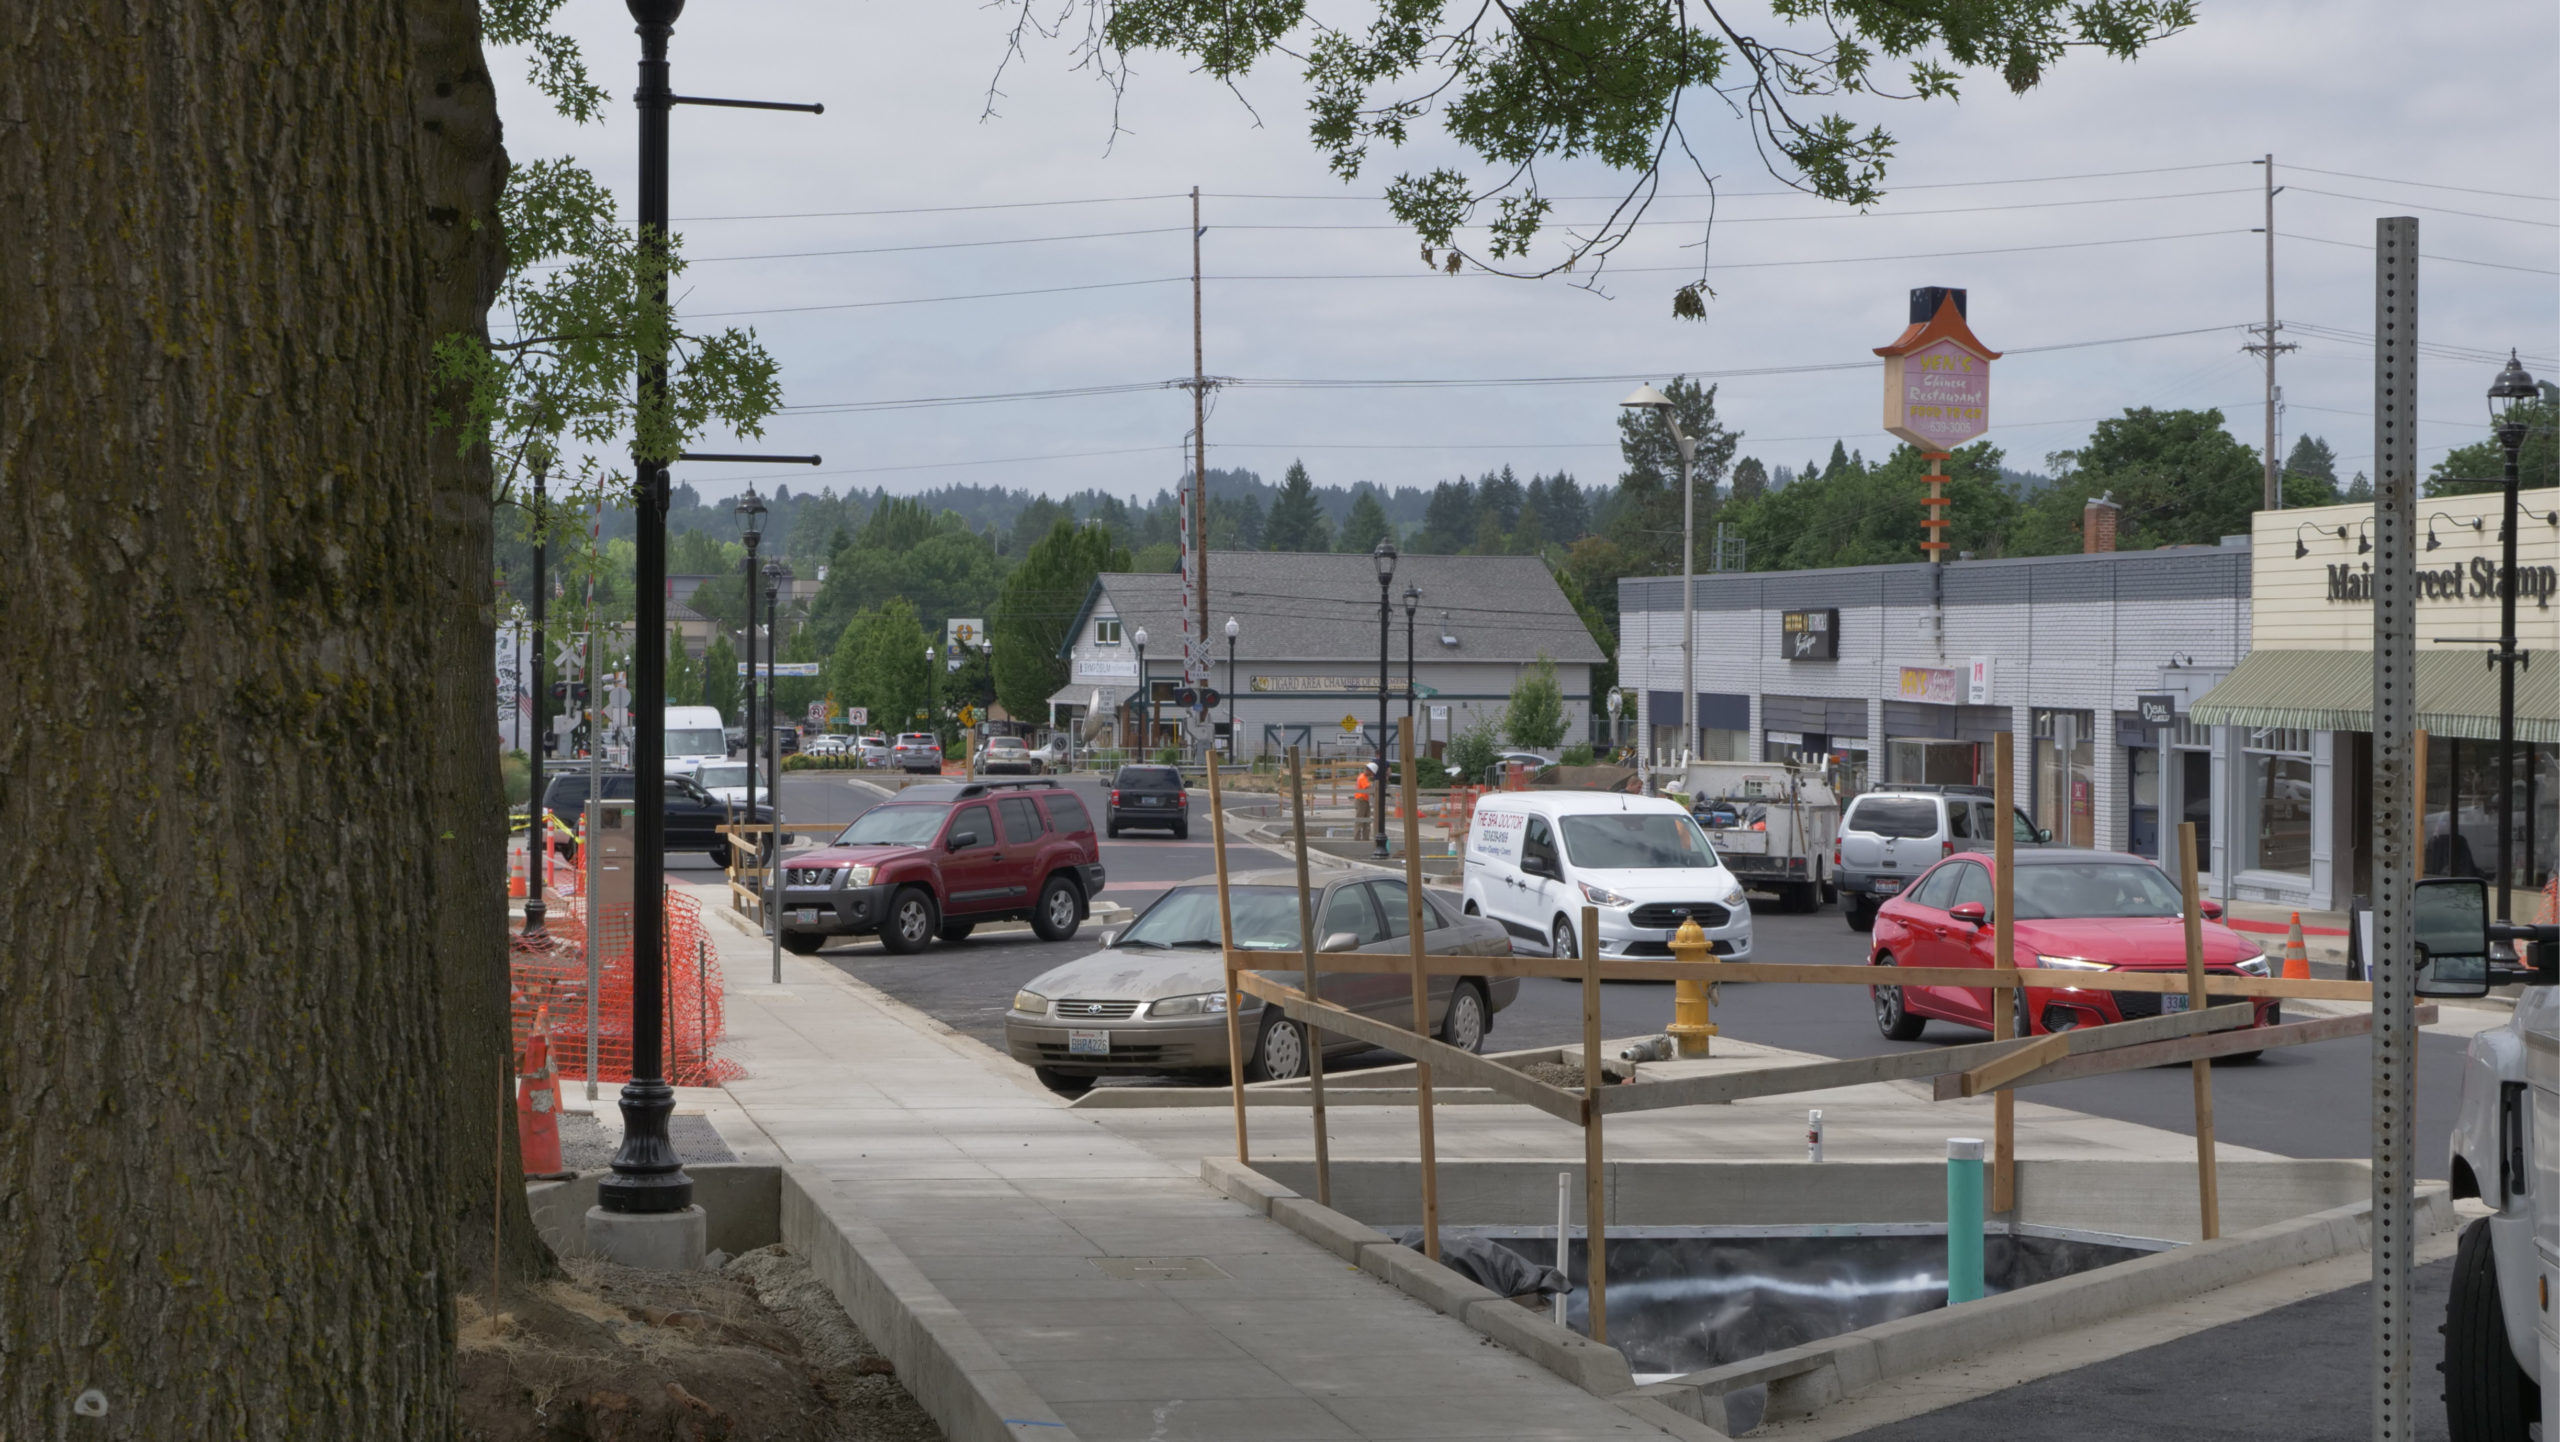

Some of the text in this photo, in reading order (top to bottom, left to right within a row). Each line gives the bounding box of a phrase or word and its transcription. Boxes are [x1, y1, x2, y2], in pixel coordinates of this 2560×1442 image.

[1920, 354, 1972, 372] YEN'S
[1924, 374, 1967, 388] Chinese
[1910, 386, 1982, 403] Restaurant
[1910, 405, 1982, 419] FOOD TO GO
[1270, 677, 1299, 690] TIGARD
[1301, 678, 1322, 689] AREA
[1478, 812, 1524, 830] THE SPA DOCTOR
